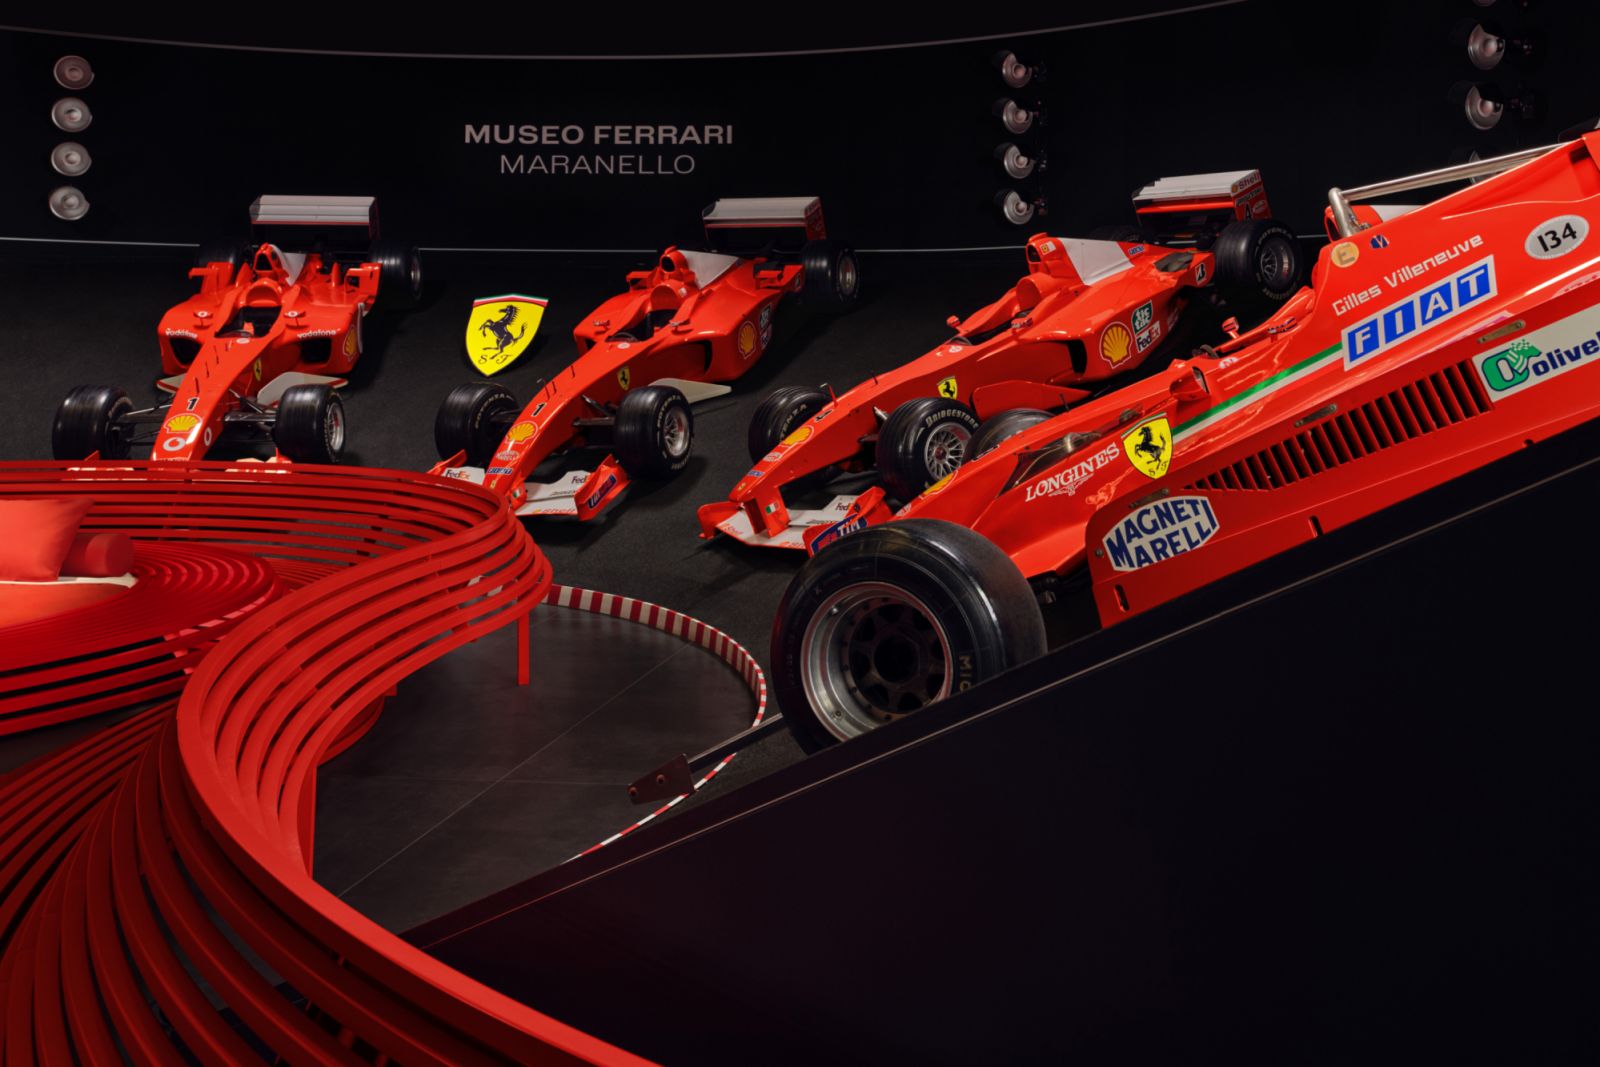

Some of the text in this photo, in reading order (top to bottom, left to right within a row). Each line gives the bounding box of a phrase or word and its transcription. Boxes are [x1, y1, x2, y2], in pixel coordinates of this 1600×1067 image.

[464, 124, 733, 145] MUSEO FERRARI
[500, 155, 696, 174] MARANELLO
[1238, 171, 1261, 190] Shell
[1537, 222, 1578, 253] 134
[1332, 234, 1484, 317] Gilles Villeneuve
[1135, 306, 1151, 321] tic
[1353, 268, 1486, 357] FIAT
[1134, 317, 1150, 330] tac
[1137, 326, 1160, 351] FedEx
[187, 397, 198, 411] 1
[531, 402, 546, 417] 1
[925, 409, 979, 429] BRIDGESTONE
[1025, 442, 1120, 502] LONGINES
[835, 503, 851, 511] Fed
[837, 520, 861, 537] TIM
[1106, 499, 1218, 562] MAGNETI
[1110, 505, 1218, 568] MARELLI
